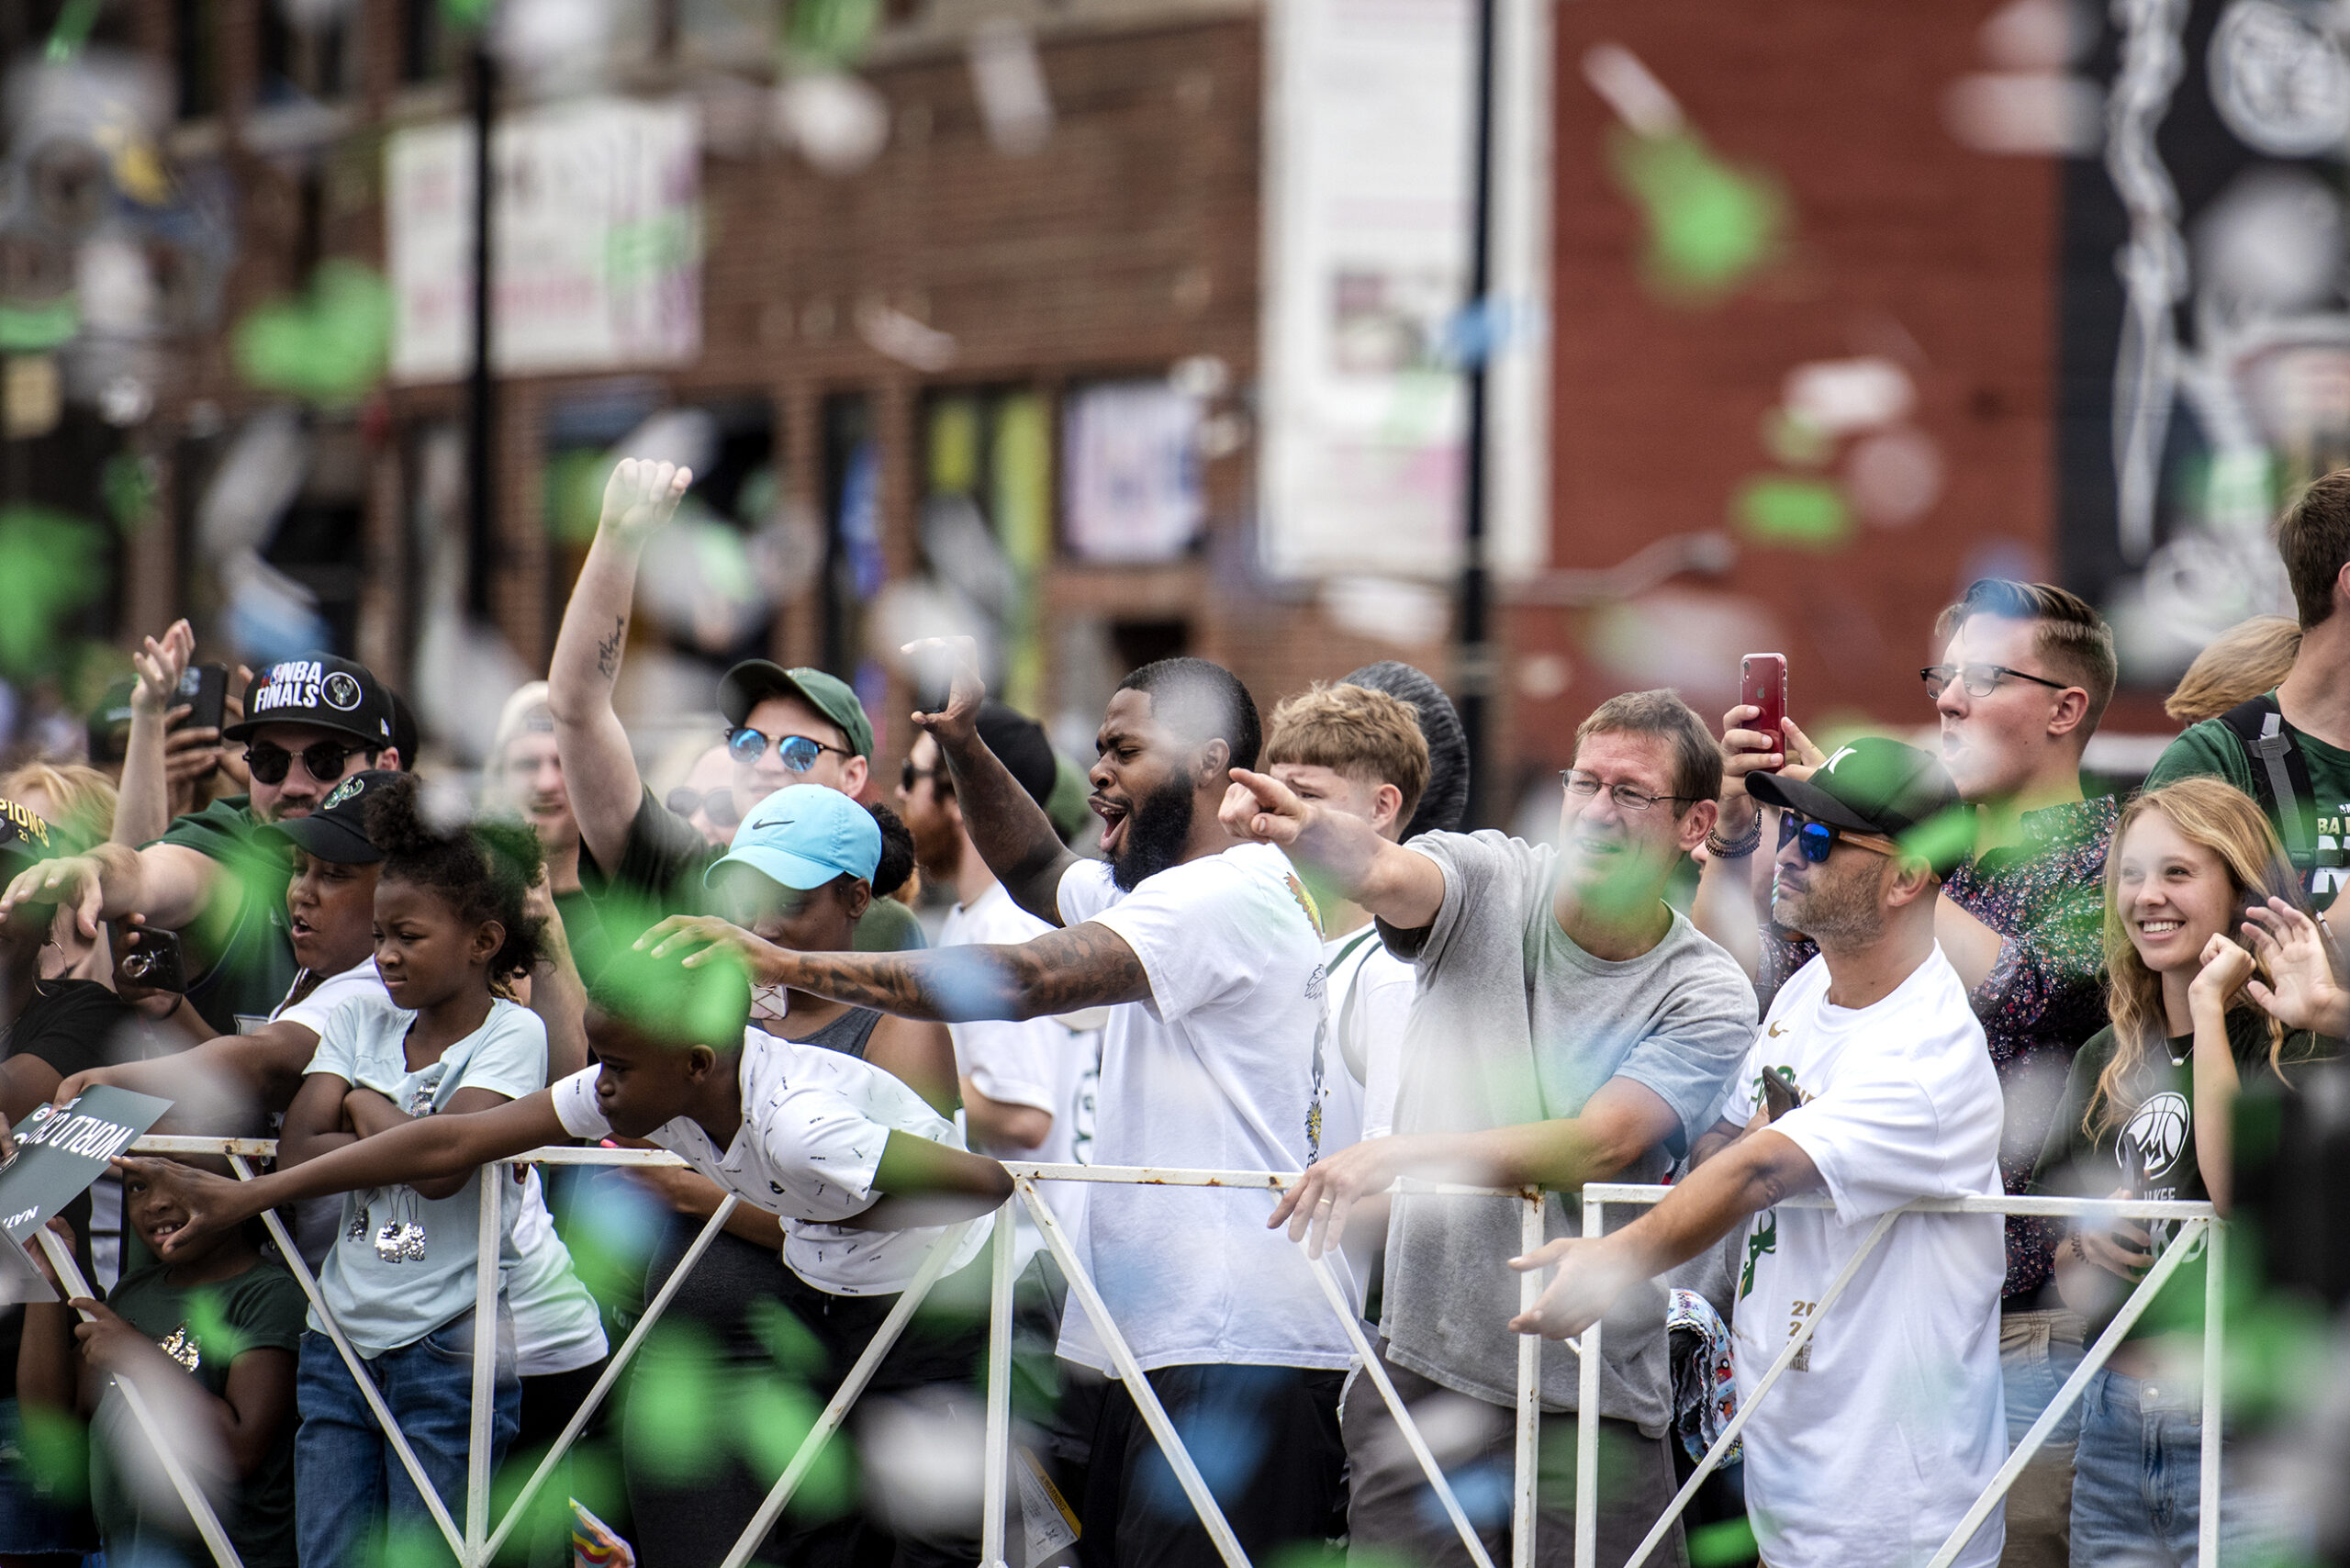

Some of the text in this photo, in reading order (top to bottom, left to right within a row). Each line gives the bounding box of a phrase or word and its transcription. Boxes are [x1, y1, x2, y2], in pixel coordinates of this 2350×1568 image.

[278, 660, 322, 685] NBA
[253, 682, 319, 713] FINALS
[2316, 816, 2341, 834] BA
[49, 1114, 135, 1161] WORLD
